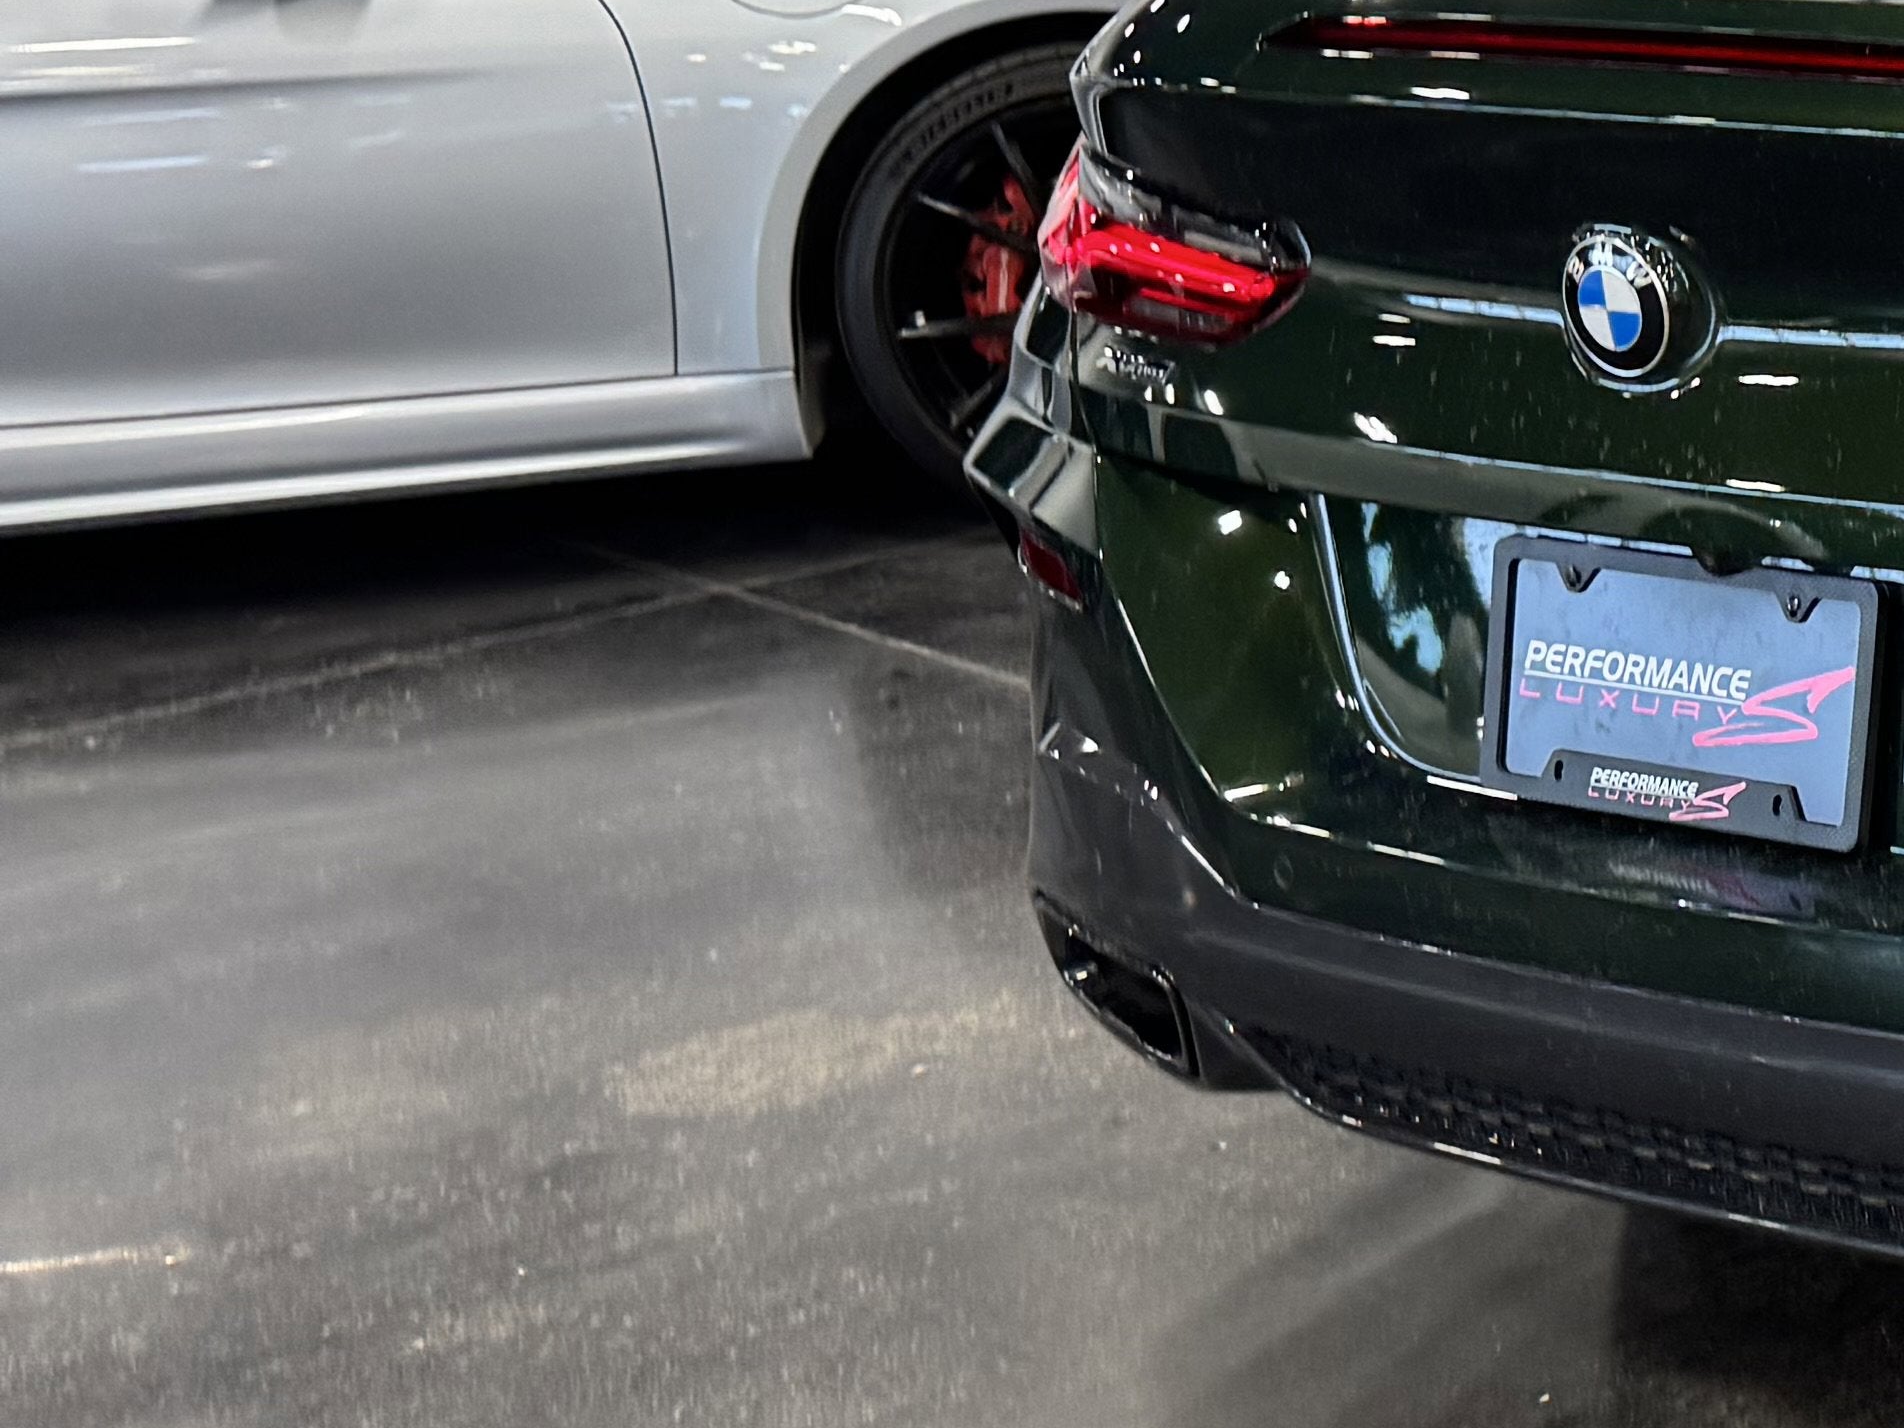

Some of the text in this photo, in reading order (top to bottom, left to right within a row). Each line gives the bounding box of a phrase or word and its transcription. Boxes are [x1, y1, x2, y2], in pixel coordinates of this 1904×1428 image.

[1568, 240, 1653, 290] BMW
[1524, 639, 1752, 700] PERFORMANCE
[1519, 678, 1739, 725] LUXURY
[1587, 785, 1691, 811] LUXURY
[1590, 766, 1699, 798] PERFORMANCE
